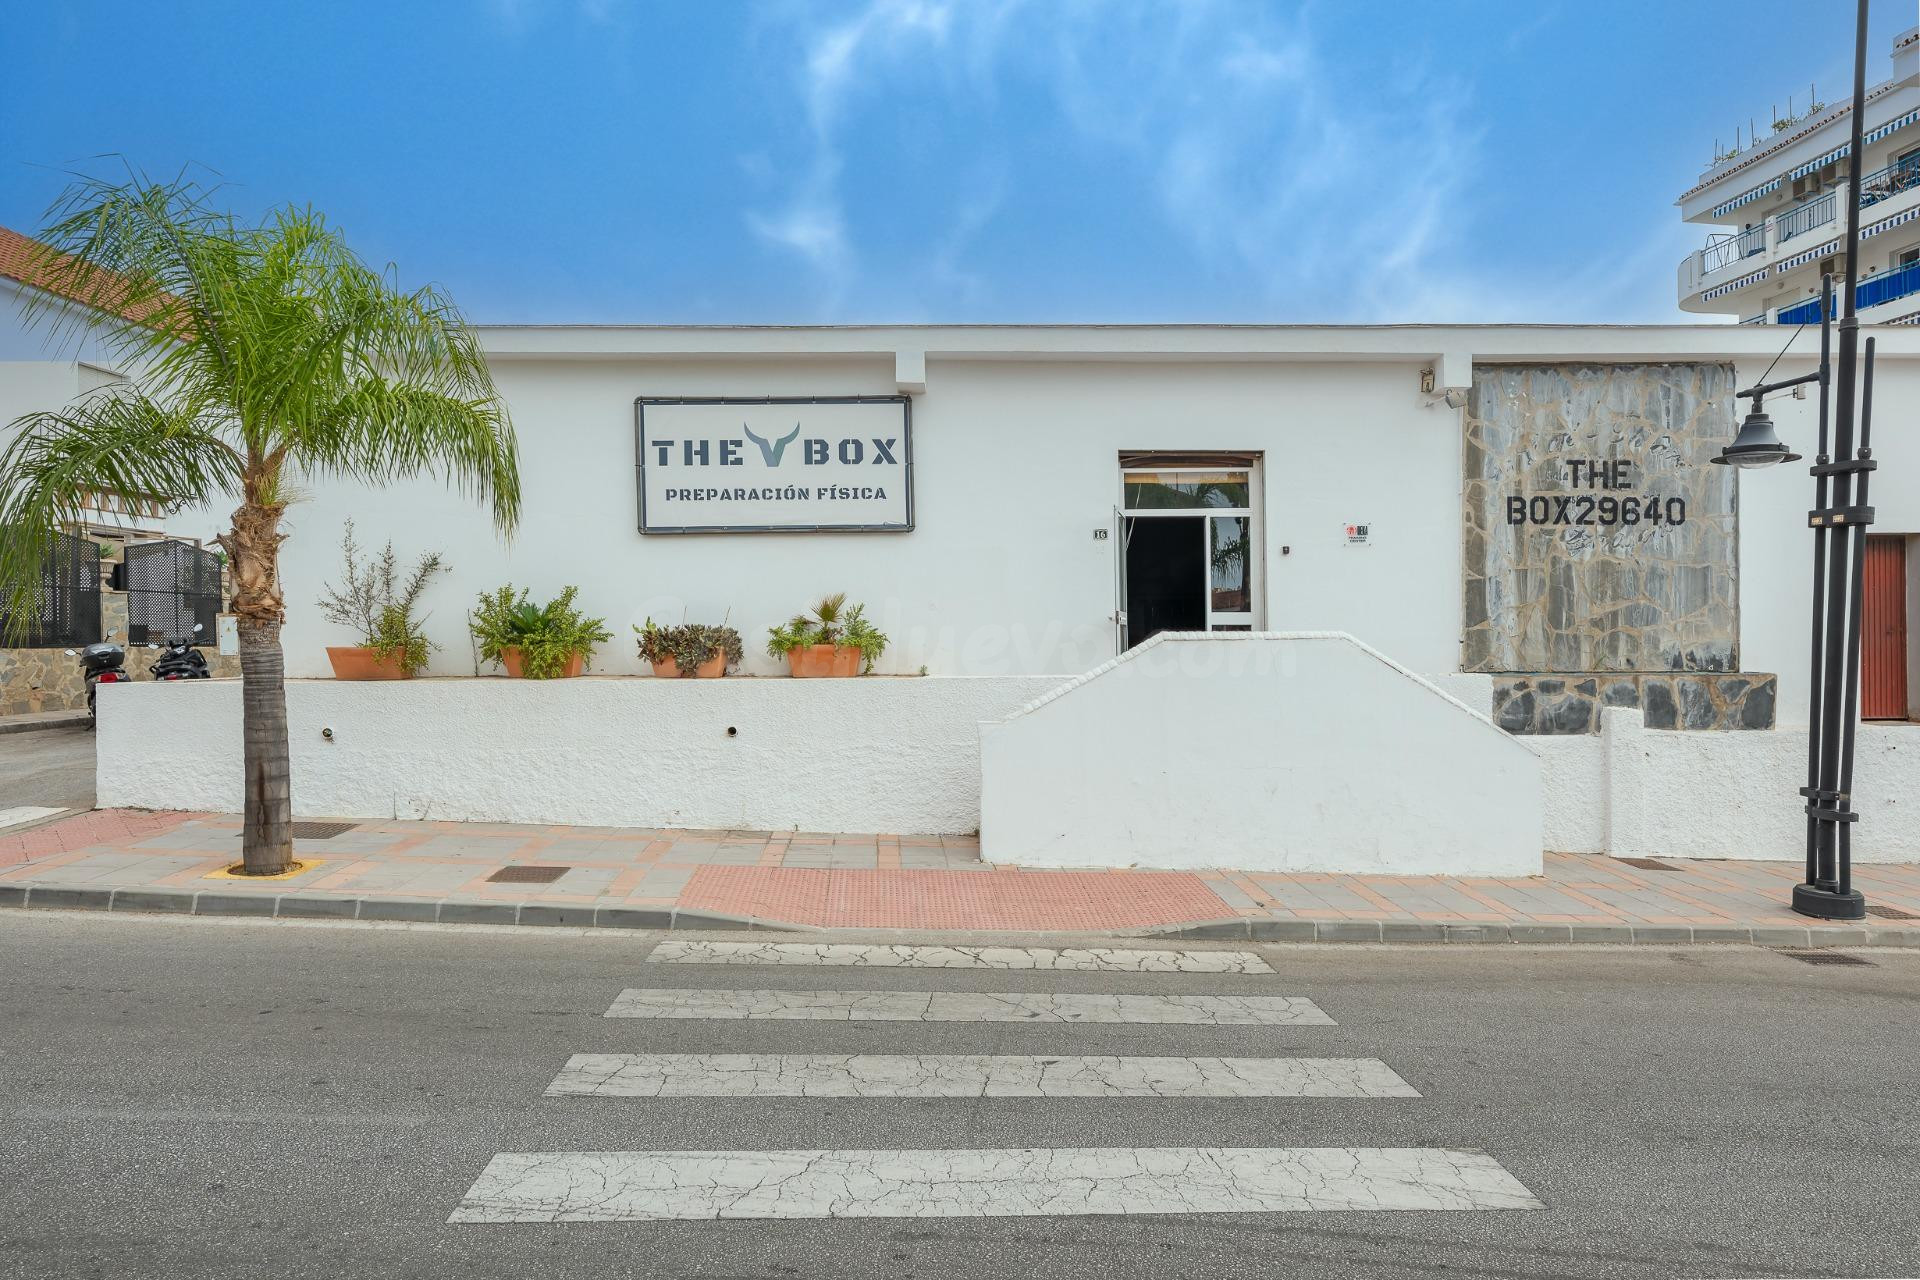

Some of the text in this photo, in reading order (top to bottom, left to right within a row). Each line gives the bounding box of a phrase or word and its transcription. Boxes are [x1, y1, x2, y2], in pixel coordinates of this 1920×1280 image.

[652, 438, 898, 466] THE BOX
[1566, 459, 1632, 489] THE
[665, 484, 887, 501] PREPARACIÓN FÍSICA
[1506, 496, 1686, 526] BOX29640
